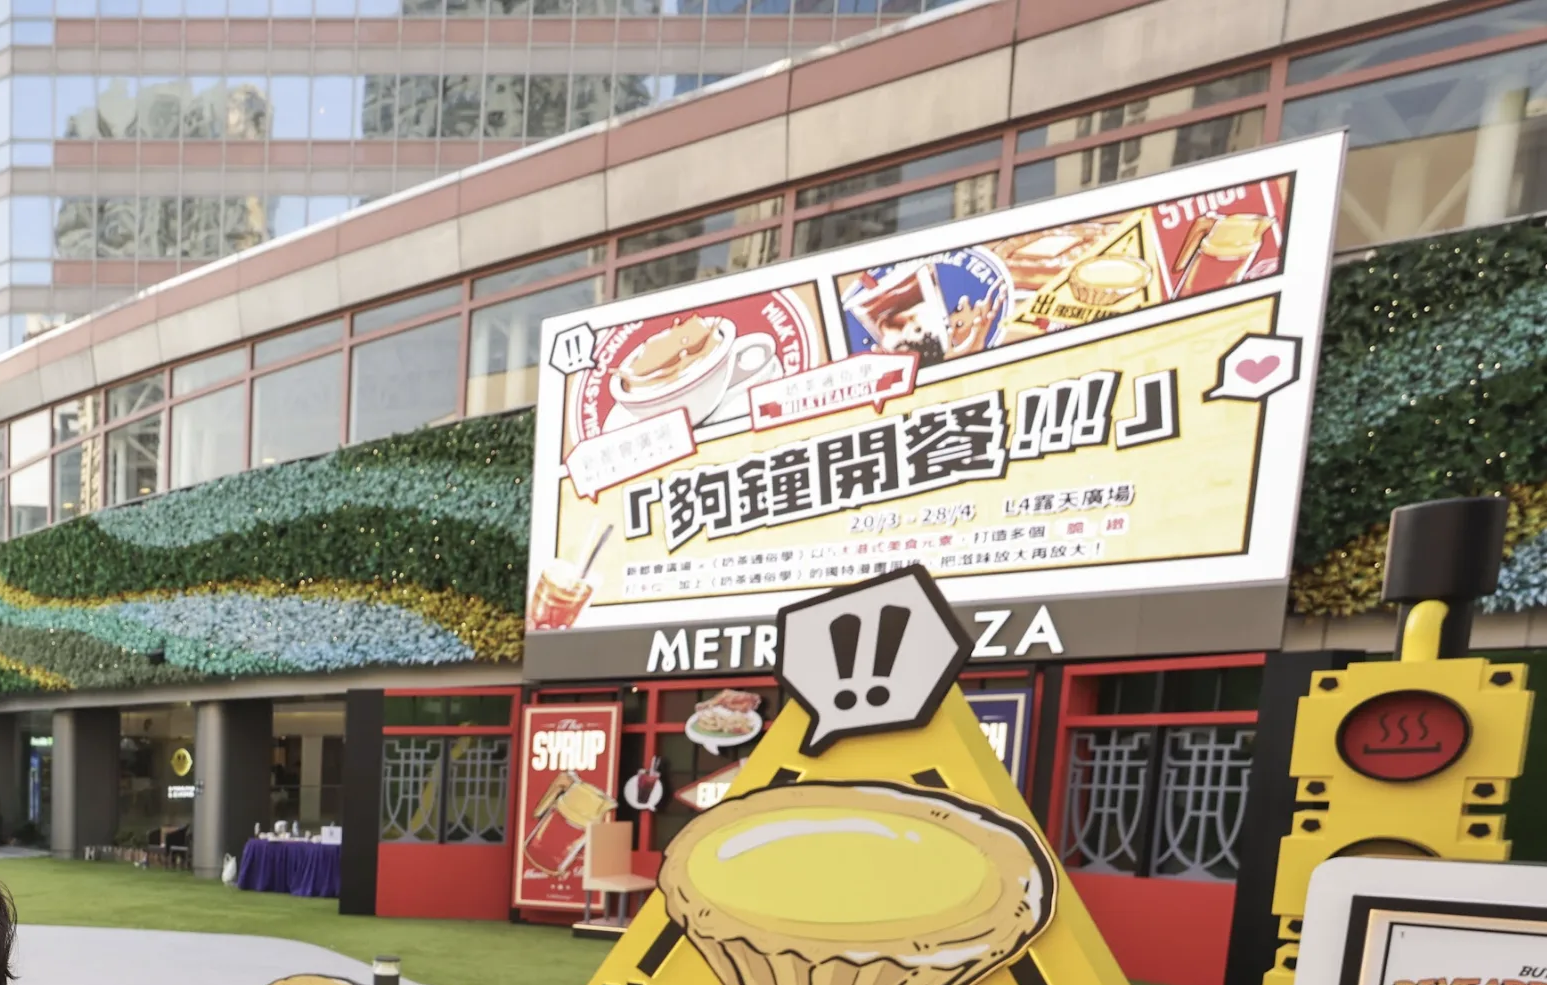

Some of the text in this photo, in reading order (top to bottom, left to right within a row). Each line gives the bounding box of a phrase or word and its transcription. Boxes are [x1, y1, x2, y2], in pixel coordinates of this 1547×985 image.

[760, 301, 799, 343] MILK
[647, 626, 777, 673] METR
[532, 730, 606, 771] SYRUP
[1519, 965, 1547, 979] BU
